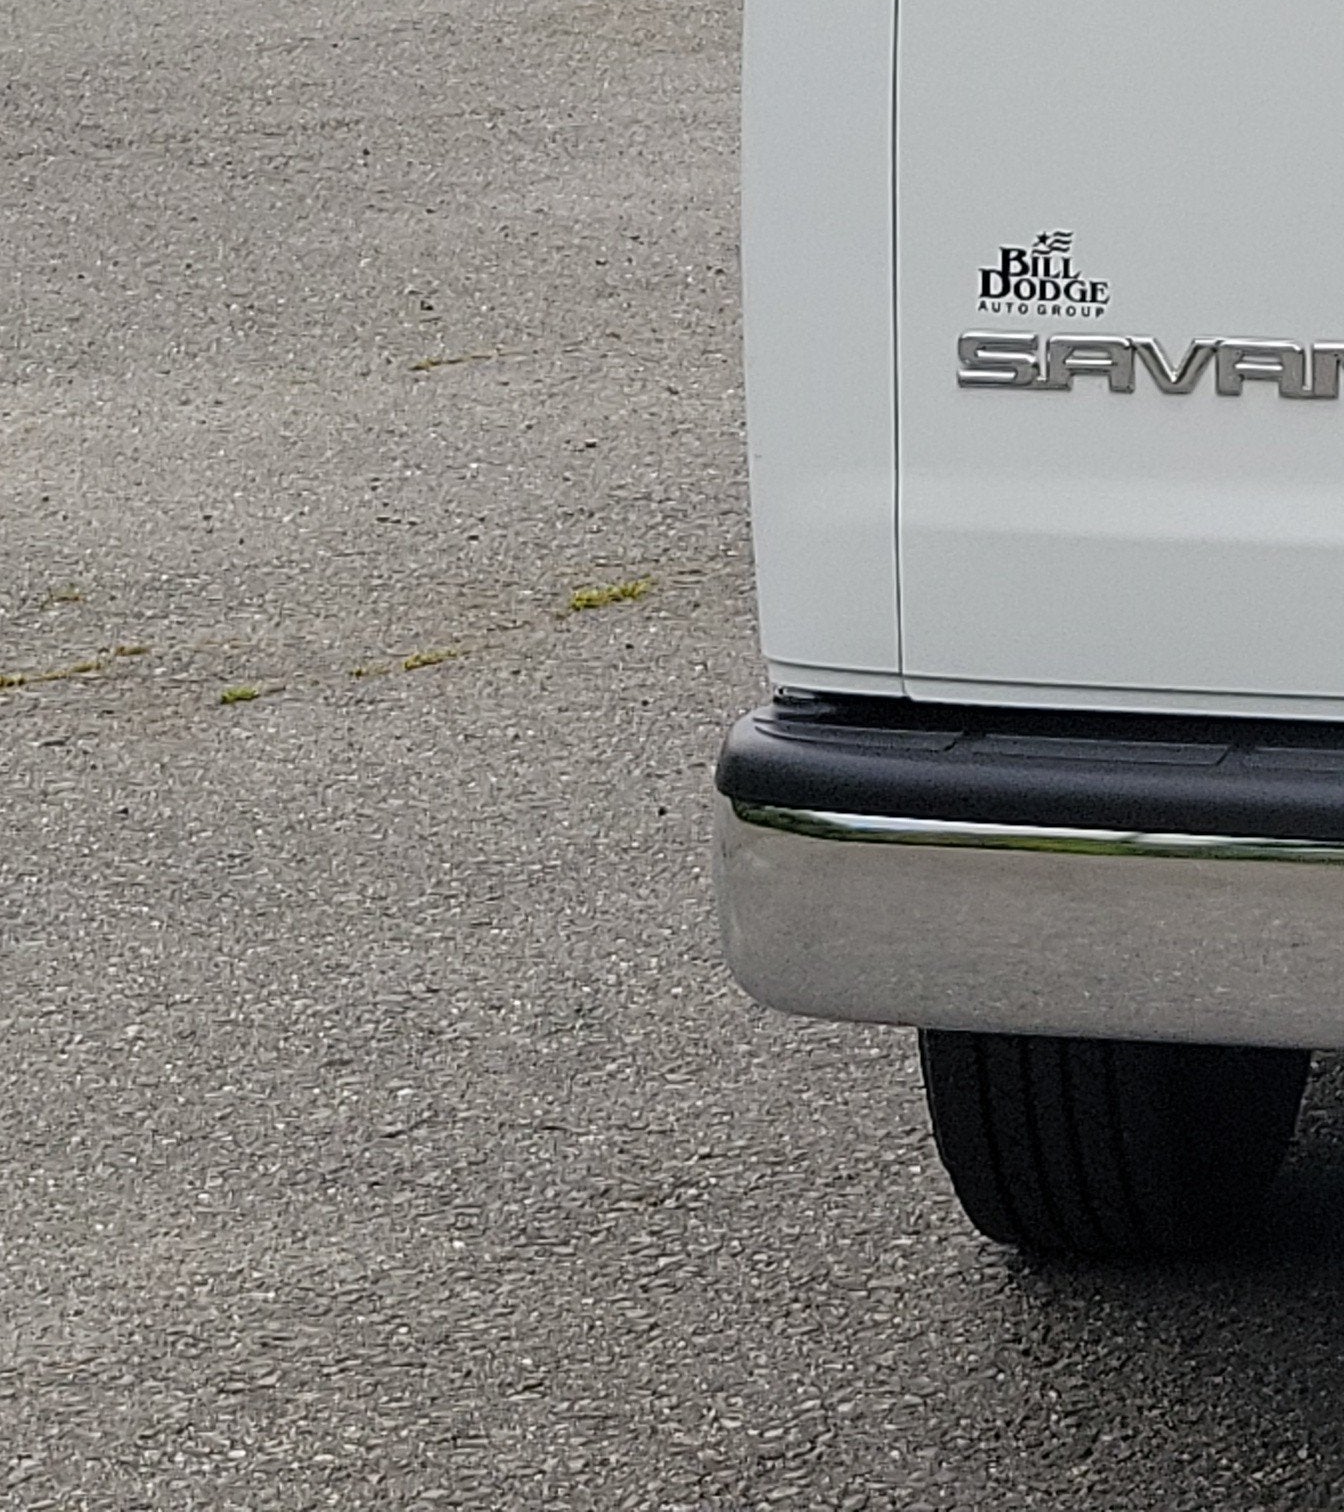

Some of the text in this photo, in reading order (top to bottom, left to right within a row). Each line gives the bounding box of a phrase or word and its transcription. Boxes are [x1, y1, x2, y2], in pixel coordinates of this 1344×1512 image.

[999, 246, 1081, 279] BILL
[978, 268, 1110, 304] DODGE
[978, 300, 1105, 318] AUTO GROUP
